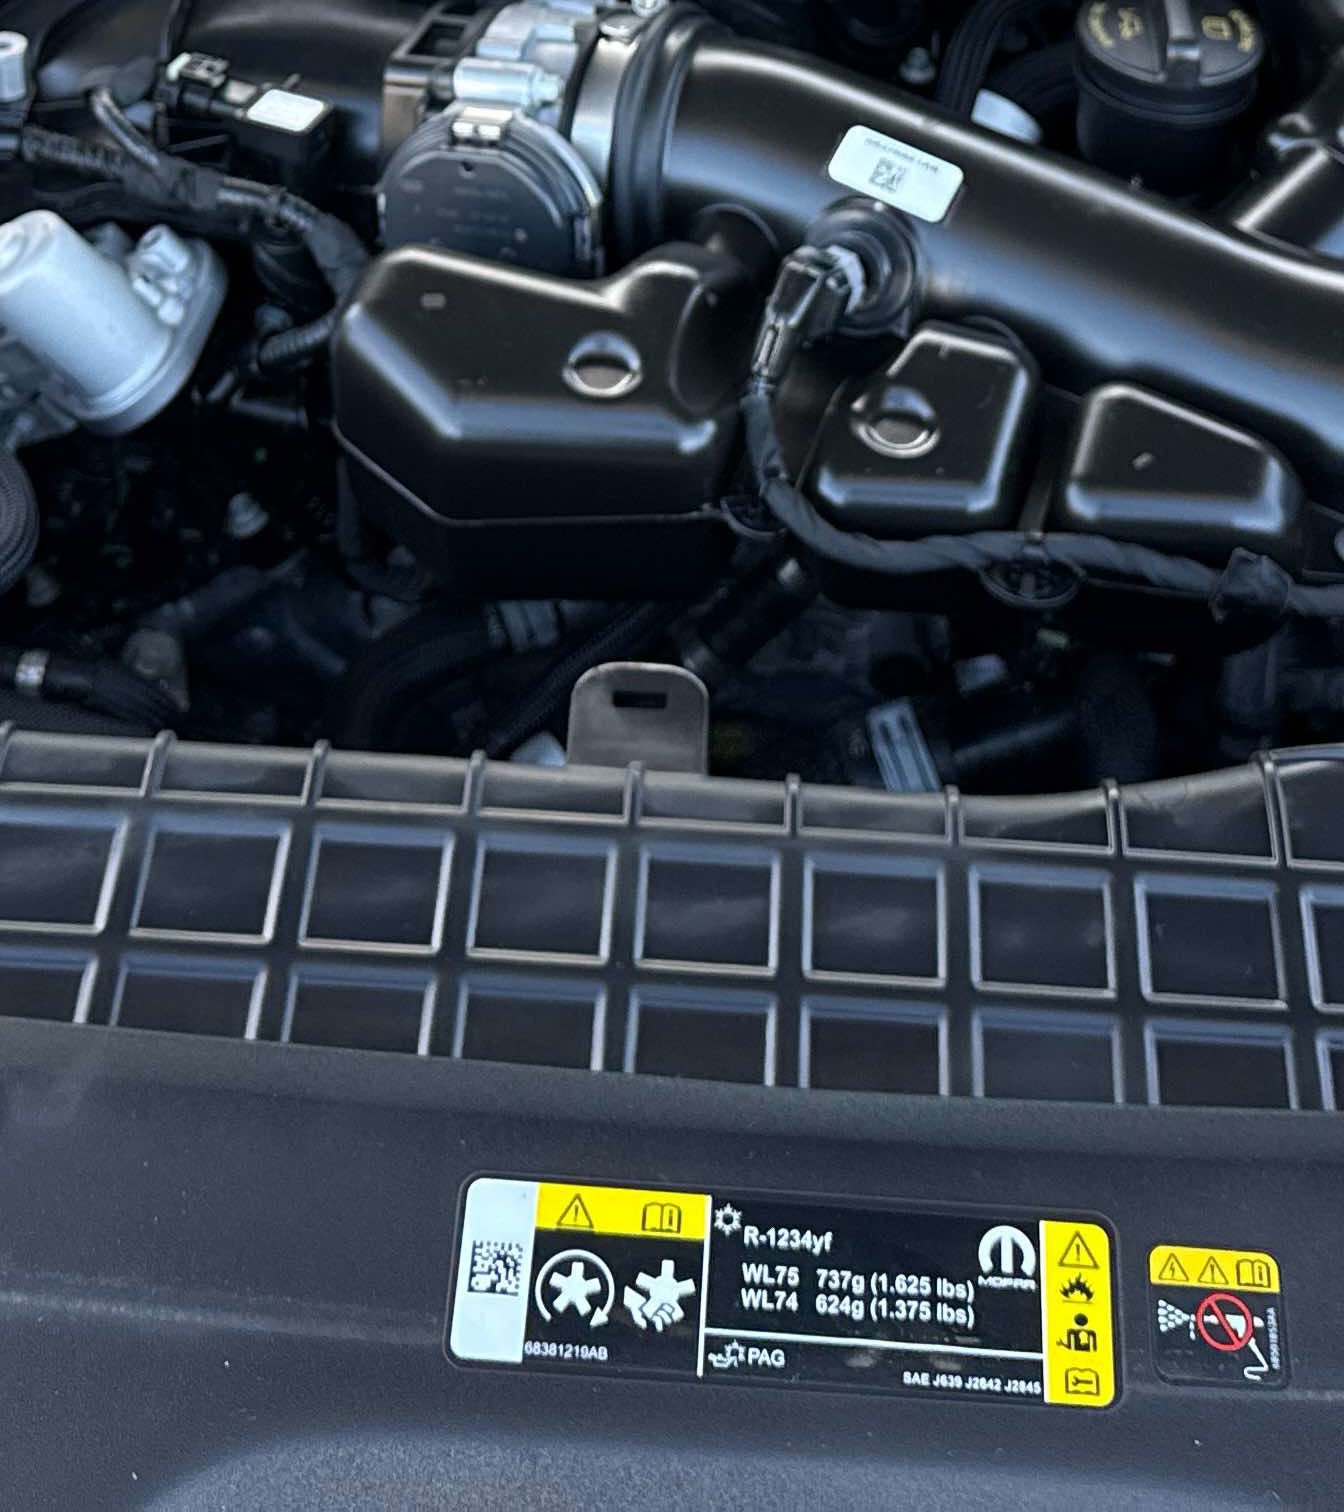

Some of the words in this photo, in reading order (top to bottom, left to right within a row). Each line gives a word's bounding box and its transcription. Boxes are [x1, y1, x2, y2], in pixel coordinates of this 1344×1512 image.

[744, 1225, 834, 1256] R-1234yf
[742, 1263, 800, 1287] WL75
[816, 1268, 865, 1295] 737g
[870, 1271, 931, 1298] (1.625
[936, 1277, 975, 1303] lbs)
[741, 1288, 799, 1312] WL74
[815, 1294, 865, 1321] 624g
[869, 1297, 931, 1323] (1.375
[936, 1300, 975, 1329] lbs)
[748, 1347, 786, 1368] PAG
[903, 1371, 930, 1386] SAE
